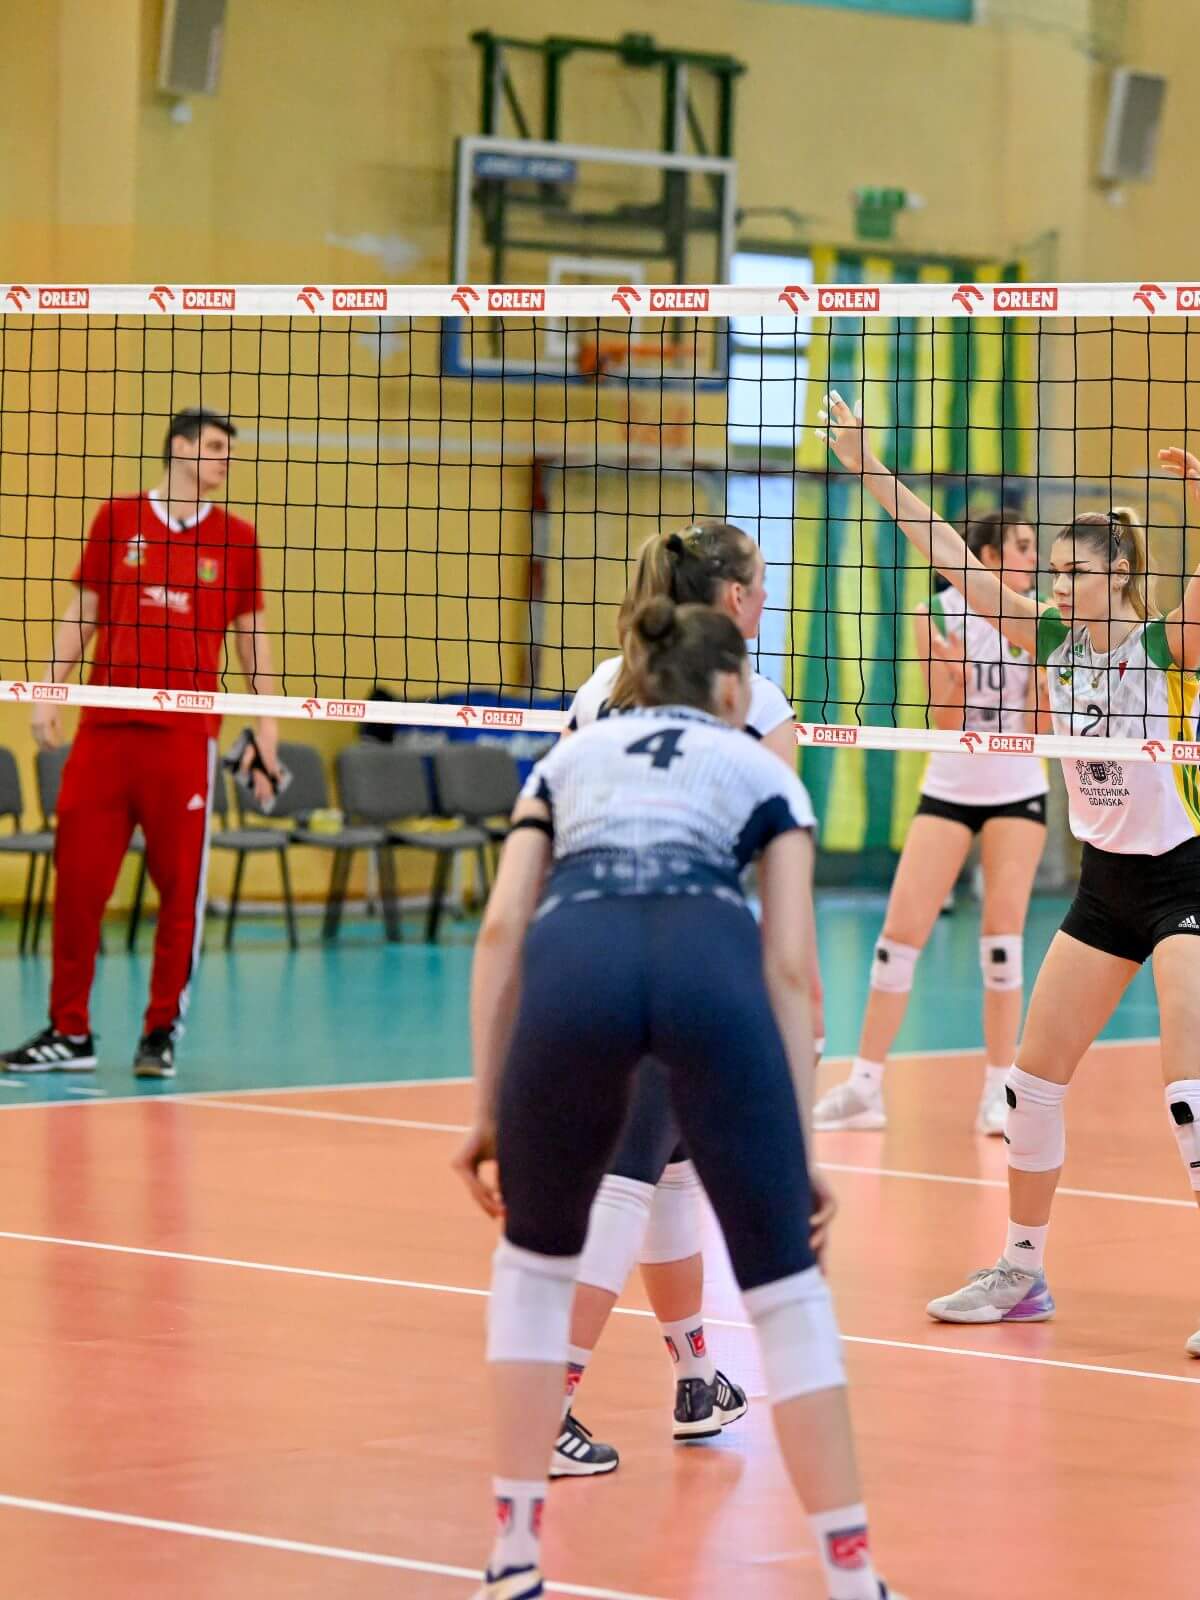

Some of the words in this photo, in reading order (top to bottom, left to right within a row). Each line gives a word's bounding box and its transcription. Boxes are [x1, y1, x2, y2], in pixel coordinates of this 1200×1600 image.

[41, 290, 87, 308] ORLEN
[185, 291, 233, 308] ORLEN
[335, 291, 385, 308] ORLEN
[490, 292, 542, 308] ORLEN
[652, 292, 706, 309] ORLEN
[821, 291, 877, 309] ORLEN
[996, 291, 1055, 309] ORLEN
[974, 662, 1006, 691] 10
[328, 703, 365, 717] ORLEN
[484, 711, 522, 725] ORLEN
[815, 728, 857, 743] ORLEN
[990, 737, 1033, 752] ORLEN
[1081, 704, 1103, 737] 2
[625, 728, 687, 770] 4
[1080, 787, 1130, 797] POLITECHNIKA
